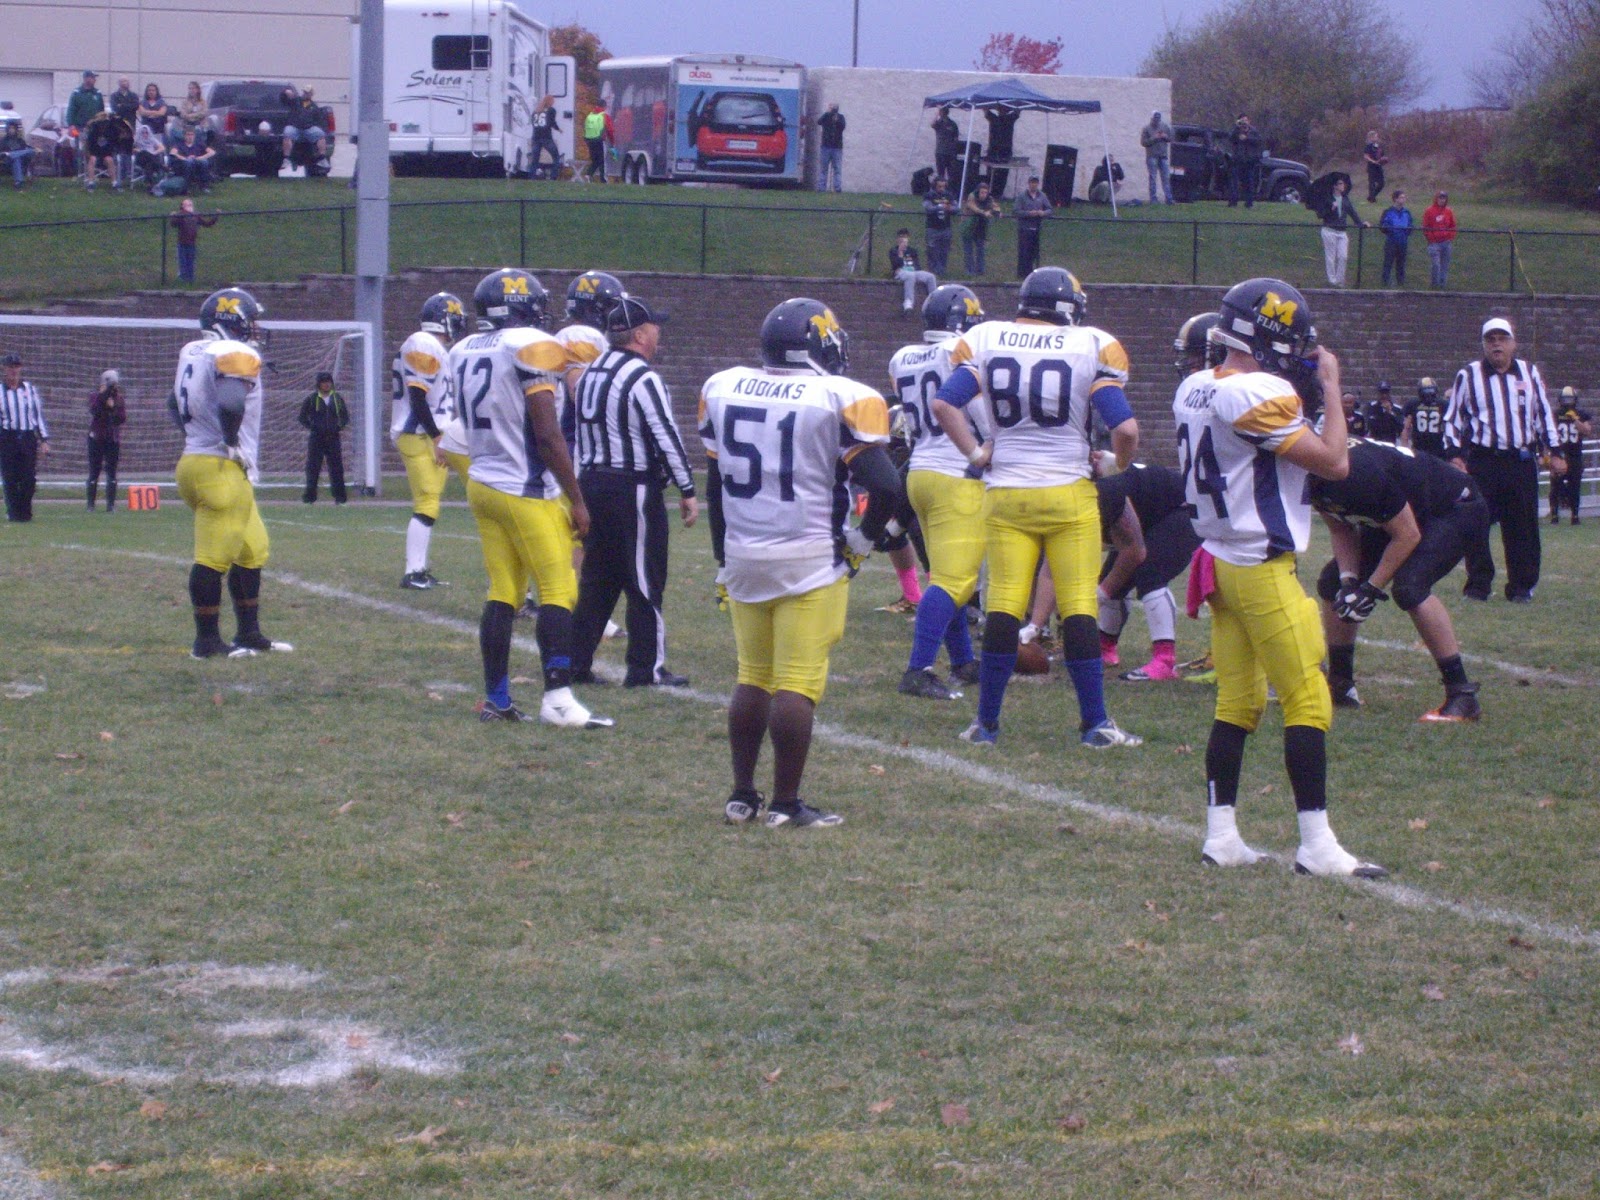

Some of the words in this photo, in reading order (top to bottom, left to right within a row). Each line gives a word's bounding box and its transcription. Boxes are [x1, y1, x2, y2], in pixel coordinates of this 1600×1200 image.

[406, 70, 462, 88] Solera
[532, 111, 547, 127] 26
[501, 277, 529, 295] M
[215, 297, 240, 314] M
[503, 294, 529, 303] FLINT
[1260, 291, 1298, 327] M
[215, 312, 238, 322] FLINT
[998, 330, 1065, 350] KODIAKS
[457, 357, 493, 430] 12
[733, 377, 806, 400] KODIAKS
[986, 356, 1072, 428] 80
[896, 370, 944, 439] 50
[1416, 410, 1440, 433] 62
[1558, 422, 1579, 444] 35
[723, 404, 797, 502] 51
[1177, 422, 1229, 520] 24
[133, 487, 158, 510] 10
